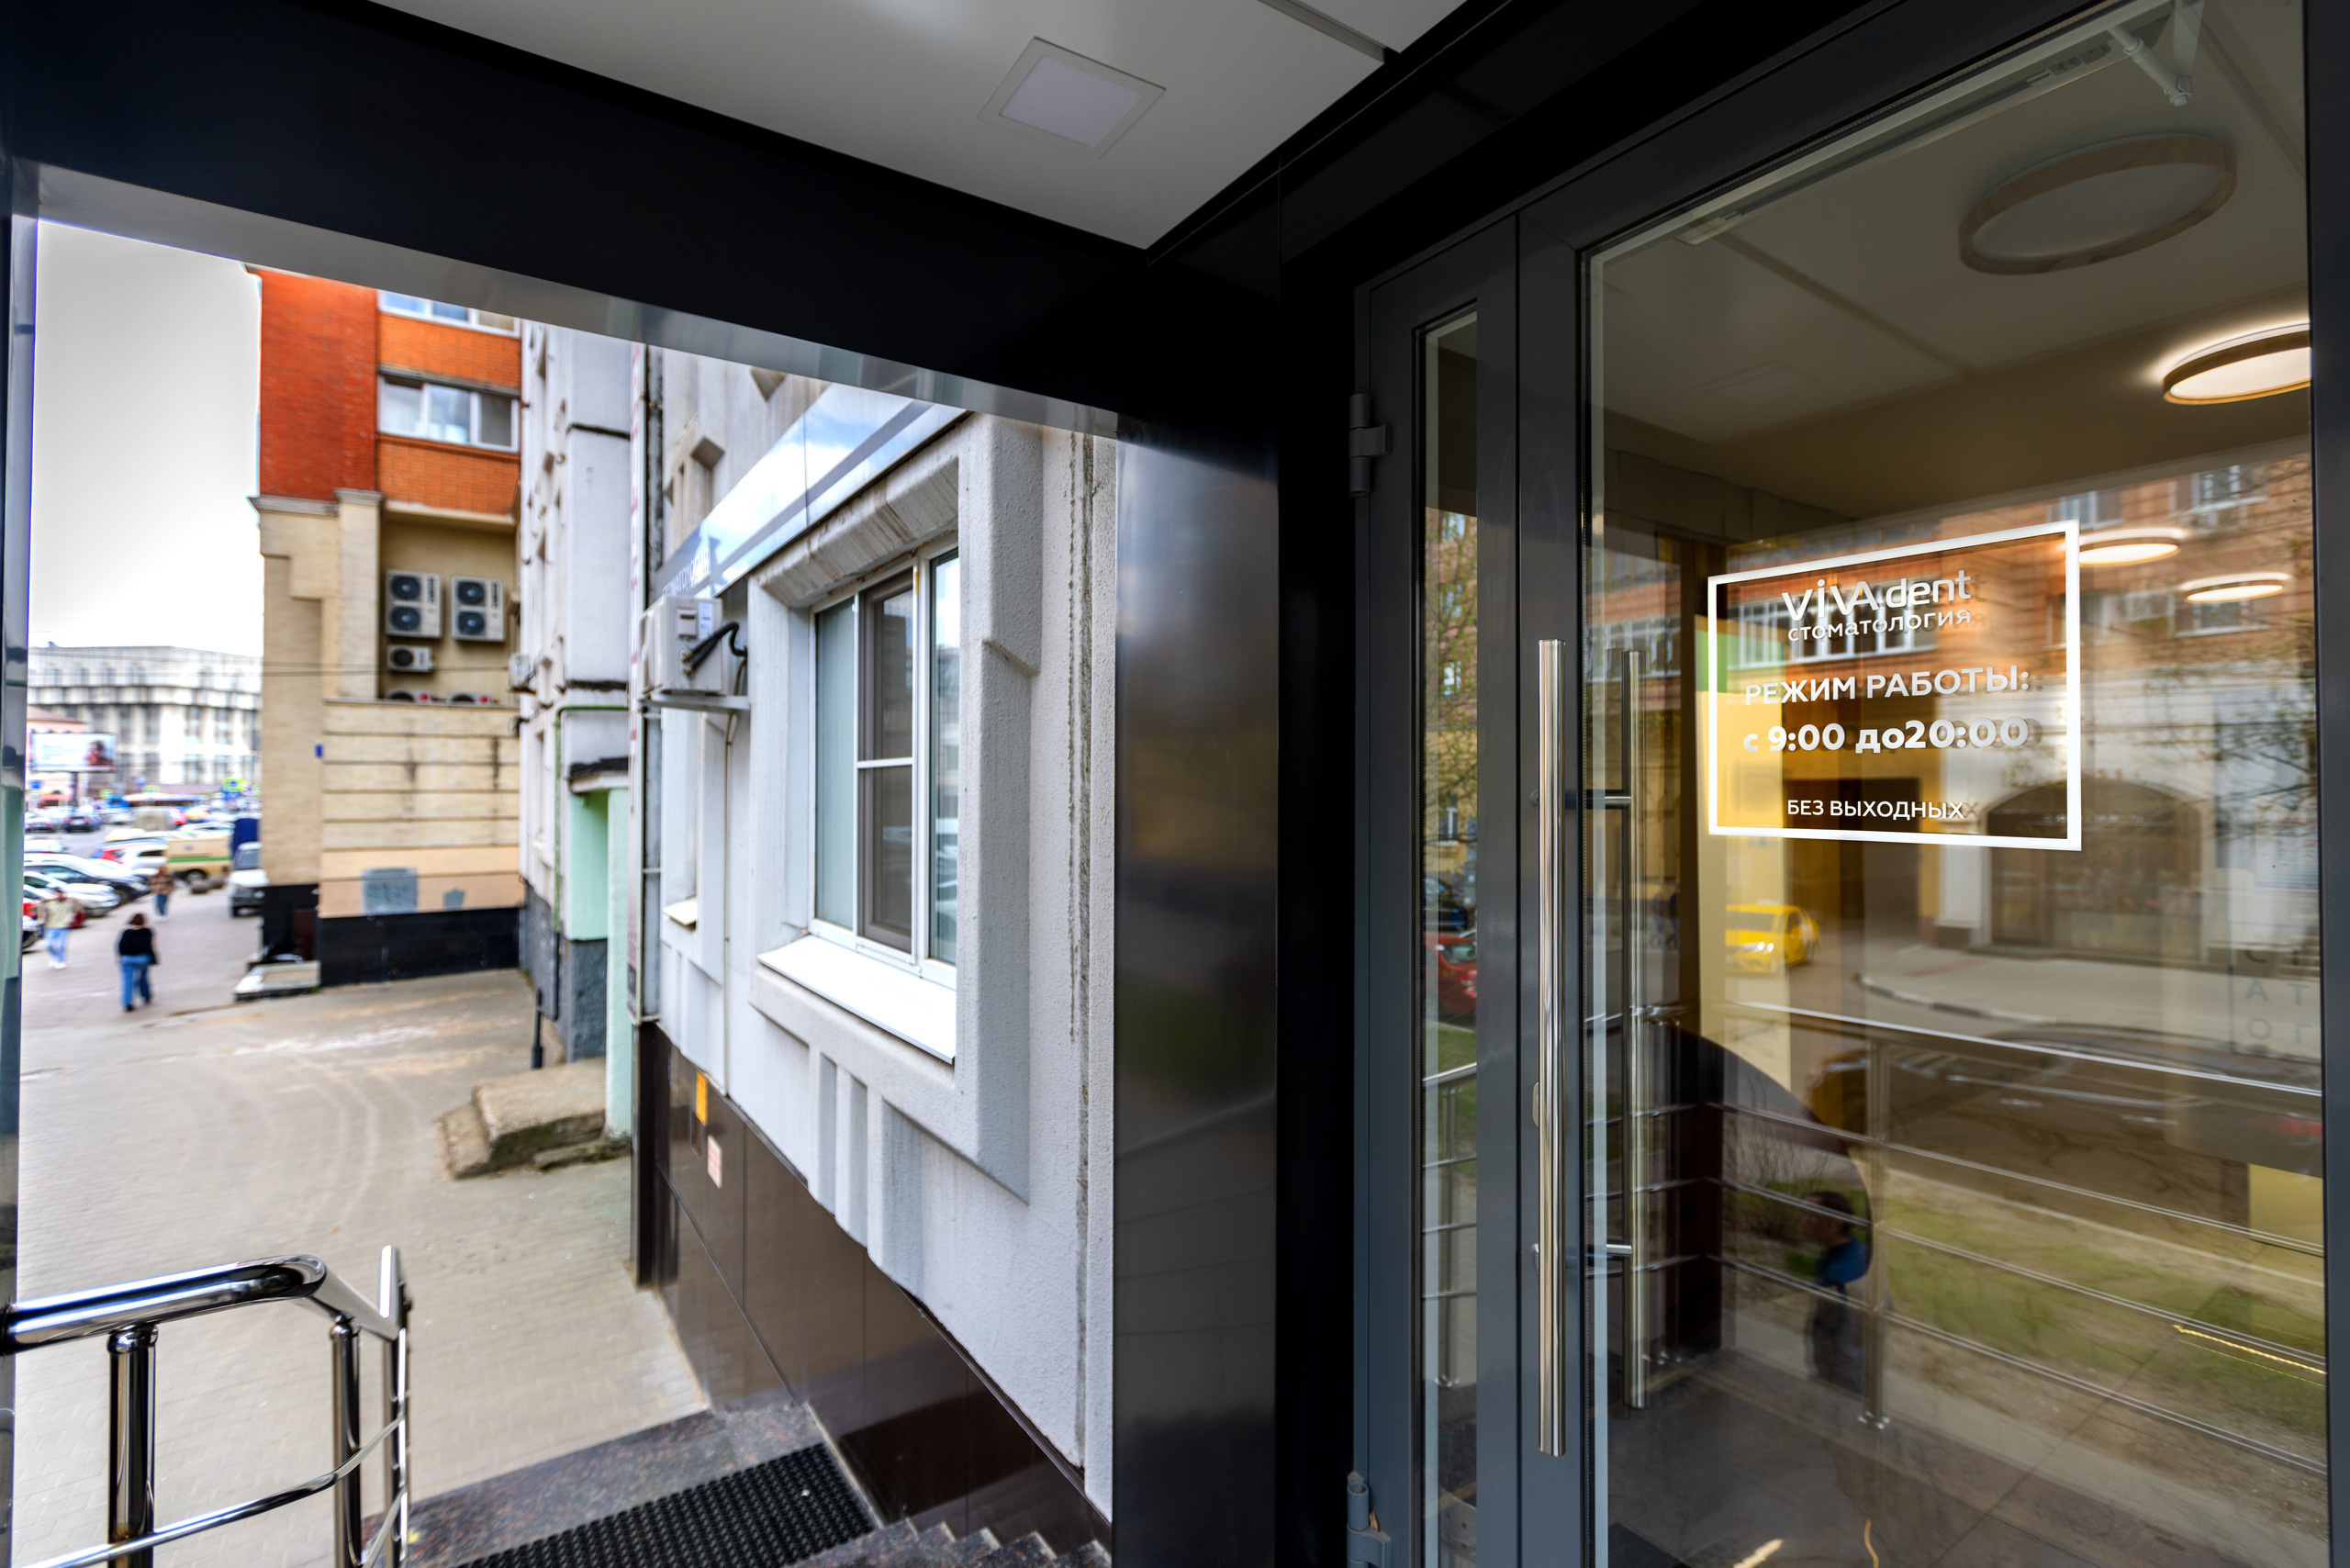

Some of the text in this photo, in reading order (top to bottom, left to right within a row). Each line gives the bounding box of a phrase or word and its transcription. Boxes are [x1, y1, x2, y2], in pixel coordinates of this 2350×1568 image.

[1788, 609, 1972, 642] стоматология
[1745, 665, 2031, 705] РЕЖИМ РАБОТЫ:
[1743, 733, 1758, 753] с
[1768, 722, 1846, 752] 9:00
[1787, 800, 1965, 821] БЕЗ ВЫХОДНЫХ
